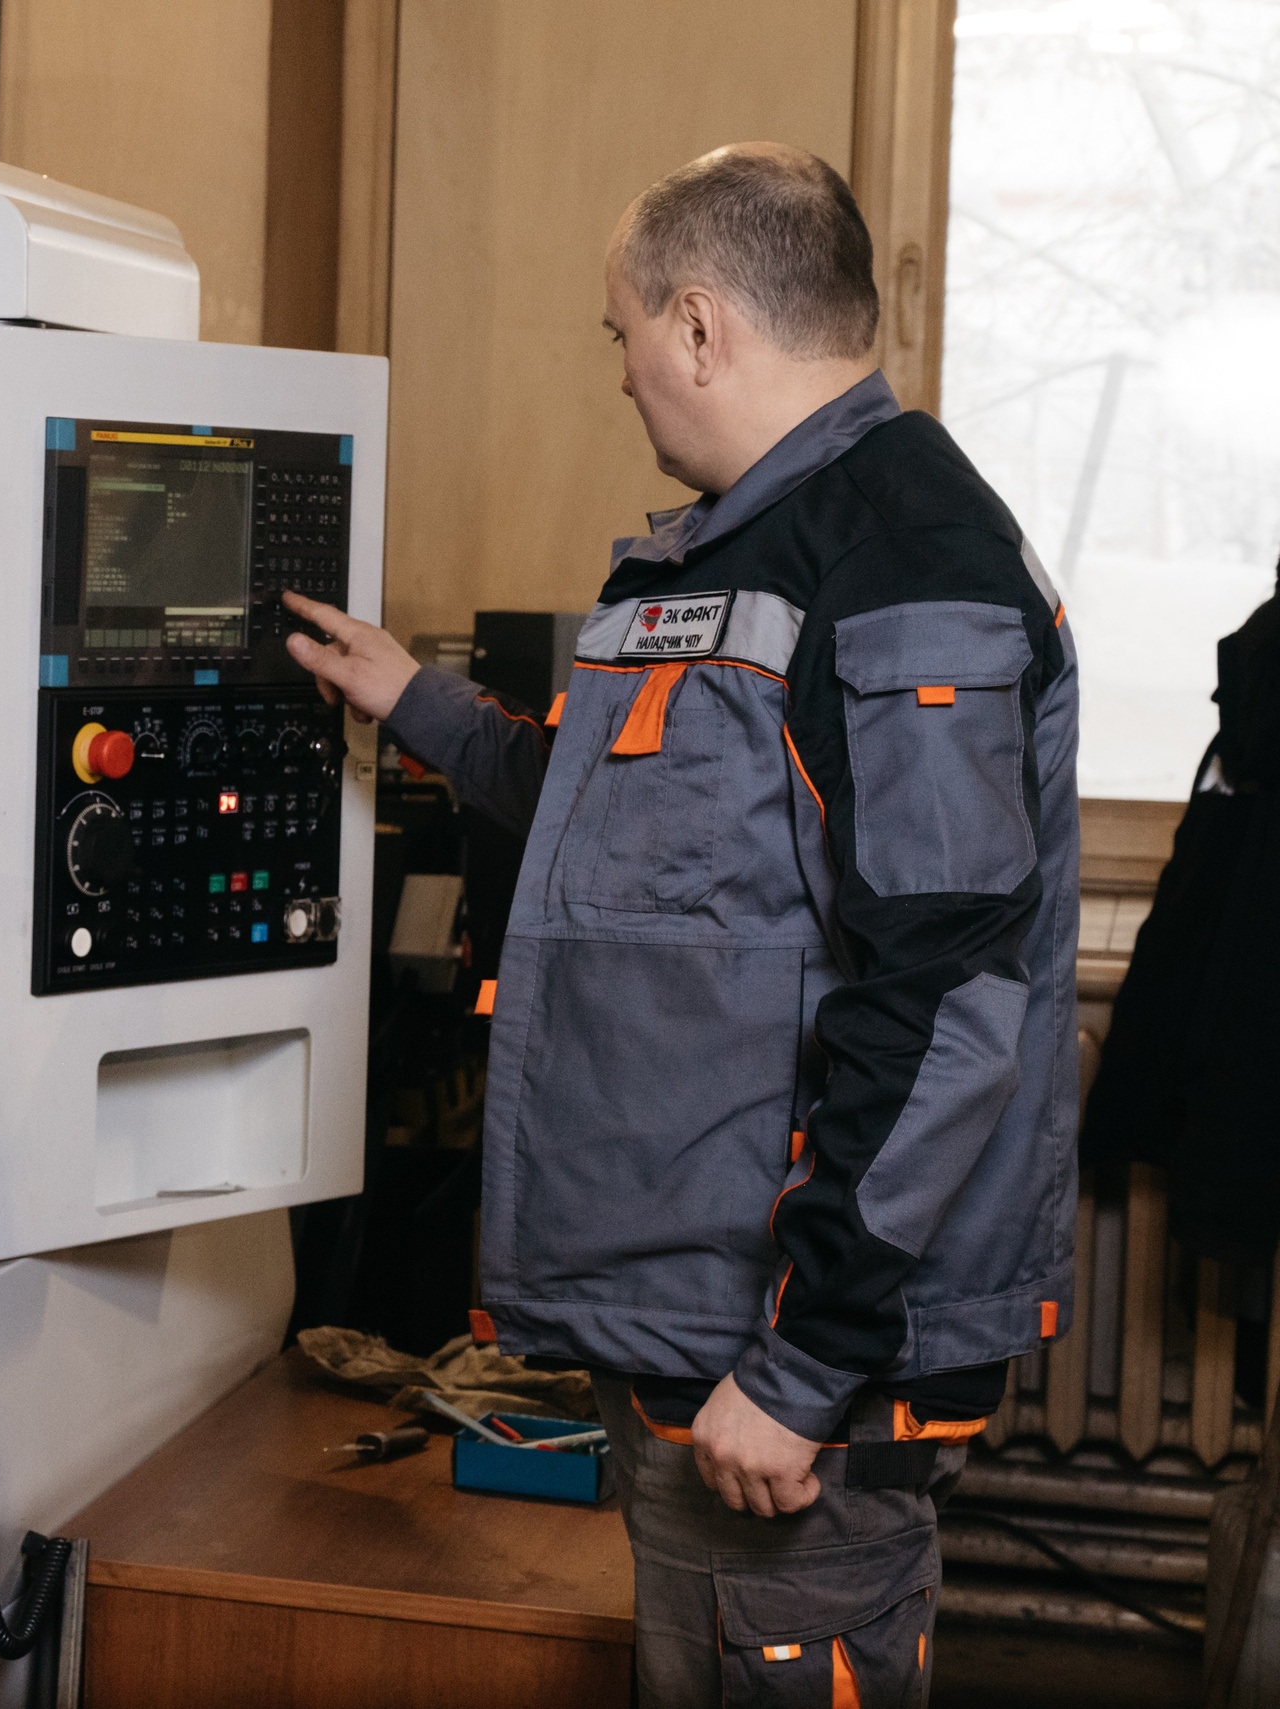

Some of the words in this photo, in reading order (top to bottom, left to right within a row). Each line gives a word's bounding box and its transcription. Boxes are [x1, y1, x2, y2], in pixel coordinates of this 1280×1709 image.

[663, 608, 681, 624] ЭК
[681, 605, 722, 622] ФАКТ
[636, 634, 684, 651] НАЛАДЧИК
[685, 634, 703, 648] ЧПУ
[83, 706, 104, 716] E-STOP
